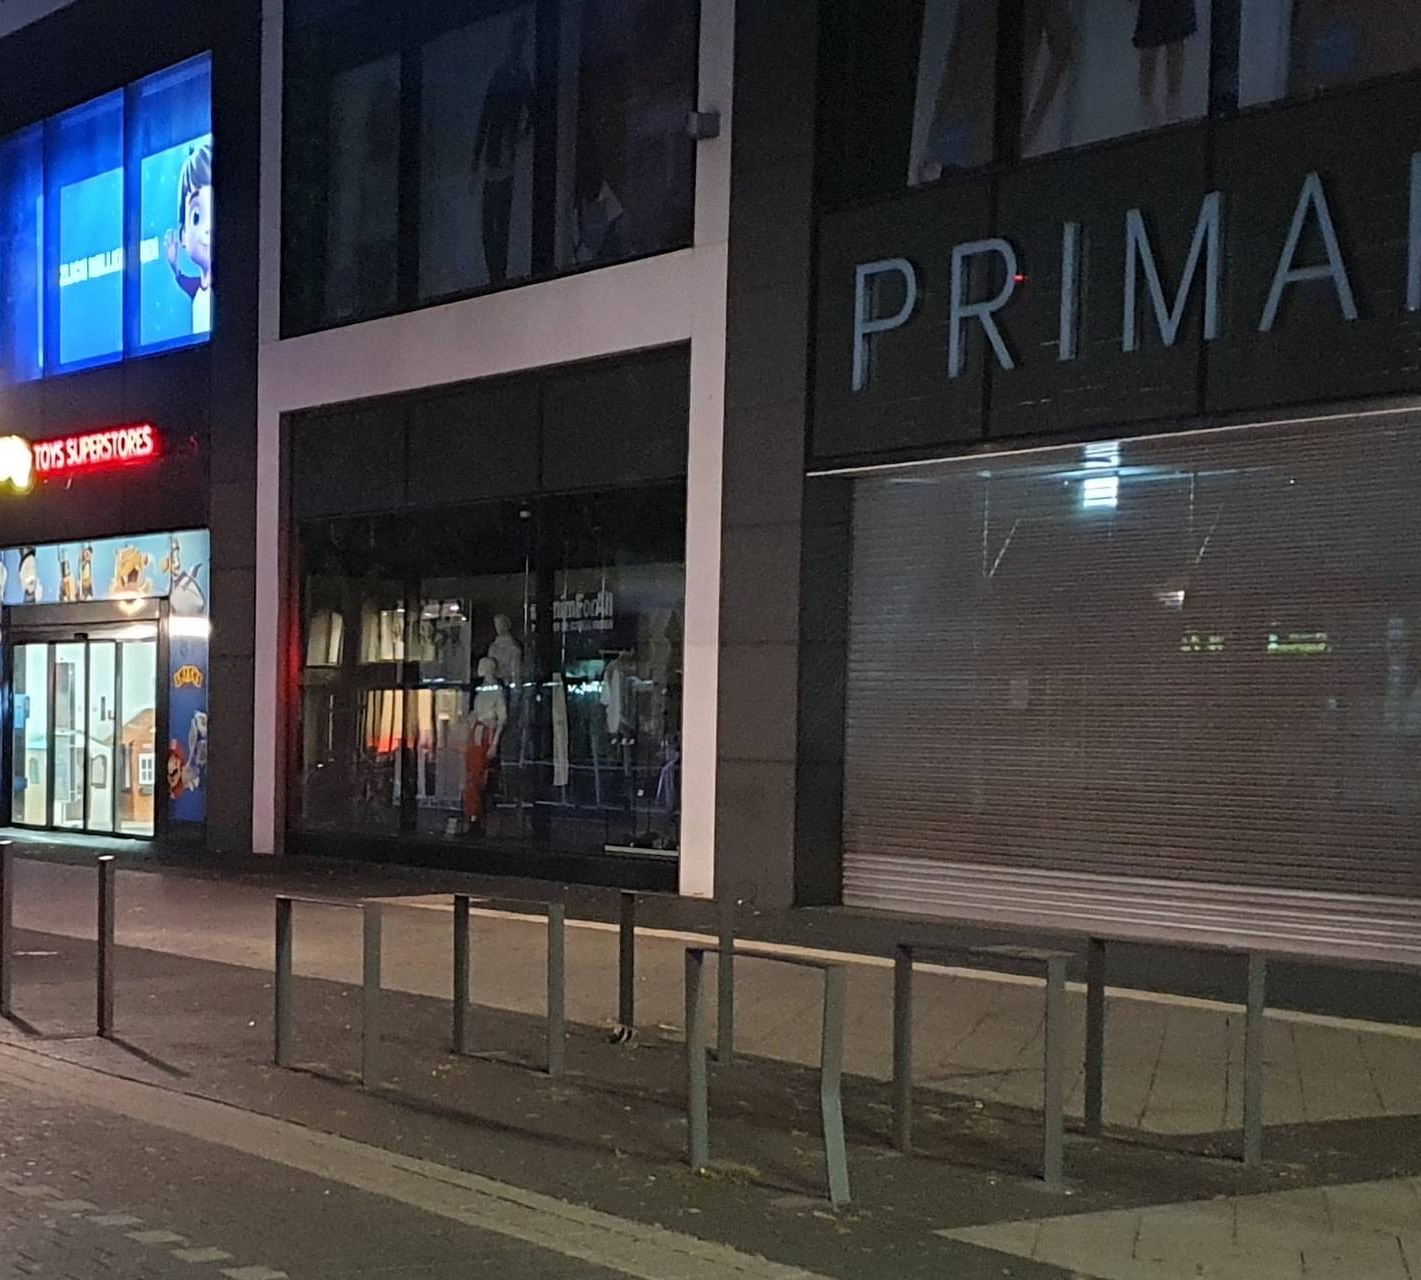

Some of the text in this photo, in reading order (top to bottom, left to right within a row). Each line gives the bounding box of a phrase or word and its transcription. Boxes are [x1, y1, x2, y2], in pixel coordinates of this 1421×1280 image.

[851, 150, 1421, 393] PRIMA
[33, 424, 154, 471] TOYS SUPERSTORES
